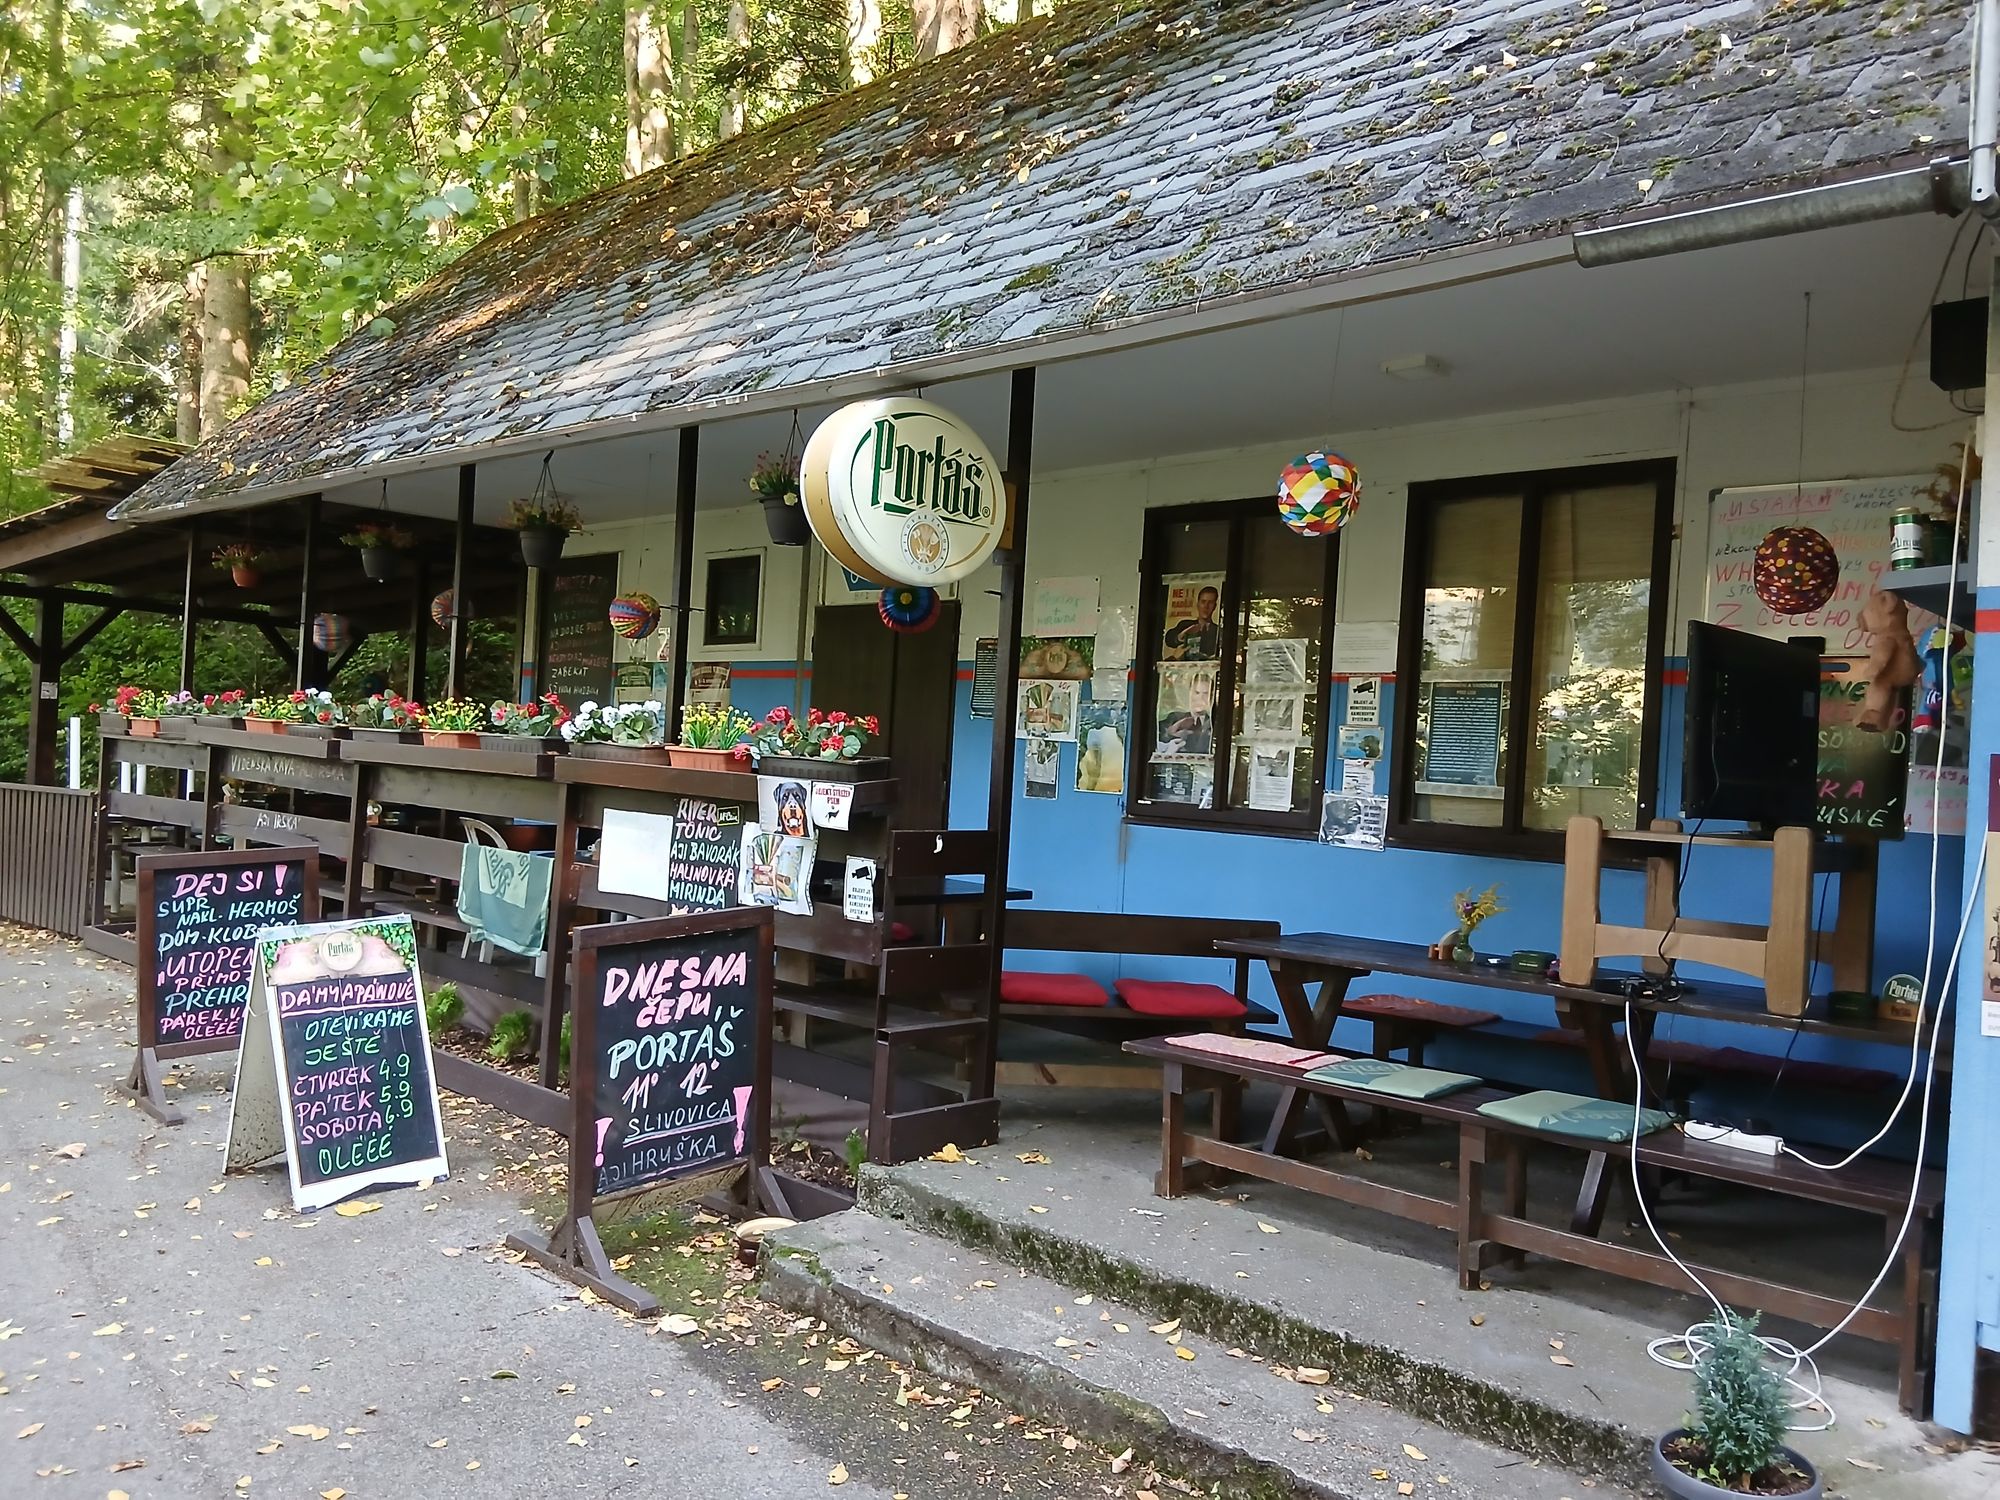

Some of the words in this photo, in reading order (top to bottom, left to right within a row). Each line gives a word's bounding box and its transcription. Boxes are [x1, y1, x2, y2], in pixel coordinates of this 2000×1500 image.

[871, 418, 984, 520] Portáš
[676, 798, 718, 823] RIVER
[675, 822, 722, 842] TONIC
[671, 841, 688, 861] AJI
[689, 840, 740, 868] BAVORÁK
[172, 873, 228, 898] DEJ
[236, 870, 264, 892] SI
[669, 880, 726, 909] MIRINDA
[636, 991, 711, 1028] ČEPU
[305, 1029, 381, 1066] JEŠTĚ
[607, 1005, 744, 1080] PORTÁŠ
[294, 1064, 375, 1096] ČTVRTEK
[295, 1090, 376, 1126] PÁTEK
[627, 1098, 732, 1138] SLIVOVICA
[301, 1110, 382, 1145] SOBOTA
[632, 1134, 717, 1175] HRUŠKA
